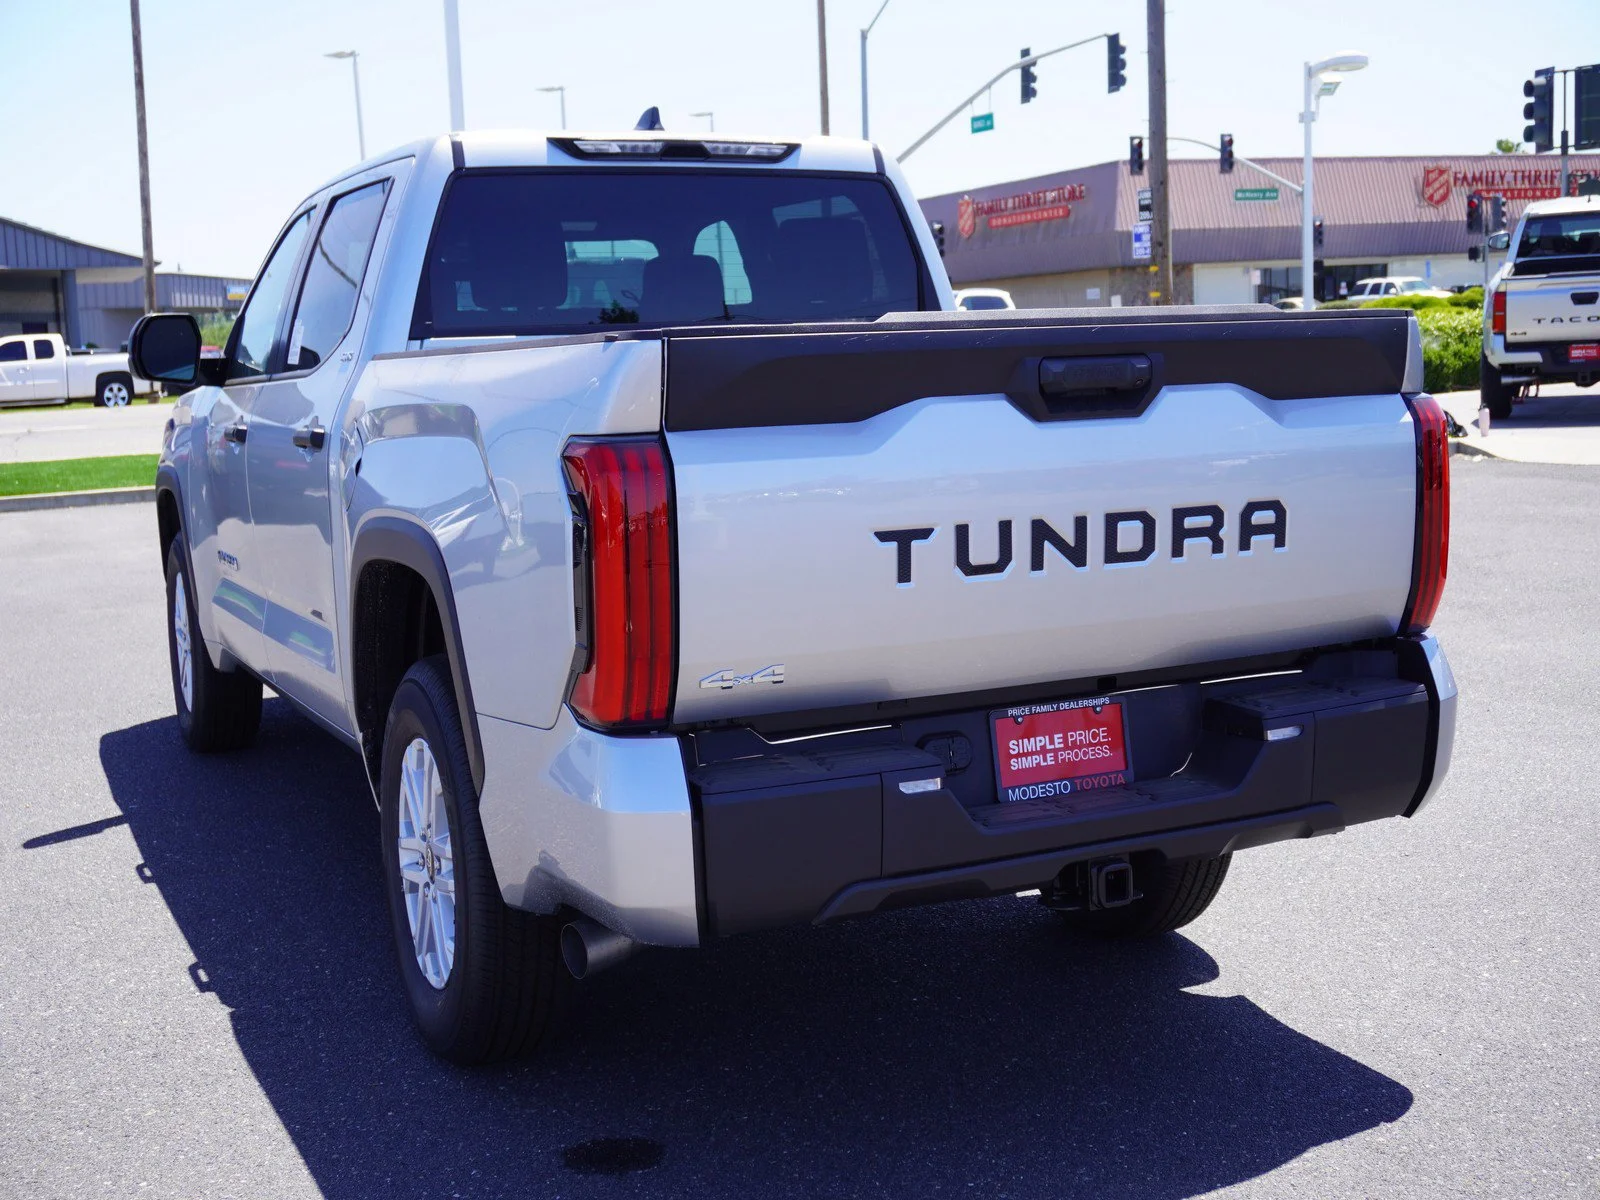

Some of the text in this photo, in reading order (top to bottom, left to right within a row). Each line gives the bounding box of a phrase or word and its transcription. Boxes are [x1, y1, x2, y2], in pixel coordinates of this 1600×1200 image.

[1453, 170, 1507, 187] FAMILY
[1511, 169, 1561, 187] THRIF
[873, 499, 1288, 587] TUNDRA
[699, 663, 785, 690] 4x4
[1008, 697, 1110, 717] PRICE FAMILY DEALERSHIPS
[1008, 727, 1112, 755] SIMPLE PRICE.
[1010, 745, 1113, 771] SIMPLE PROCESS.
[1008, 773, 1126, 802] MODESTO TOYOTA
